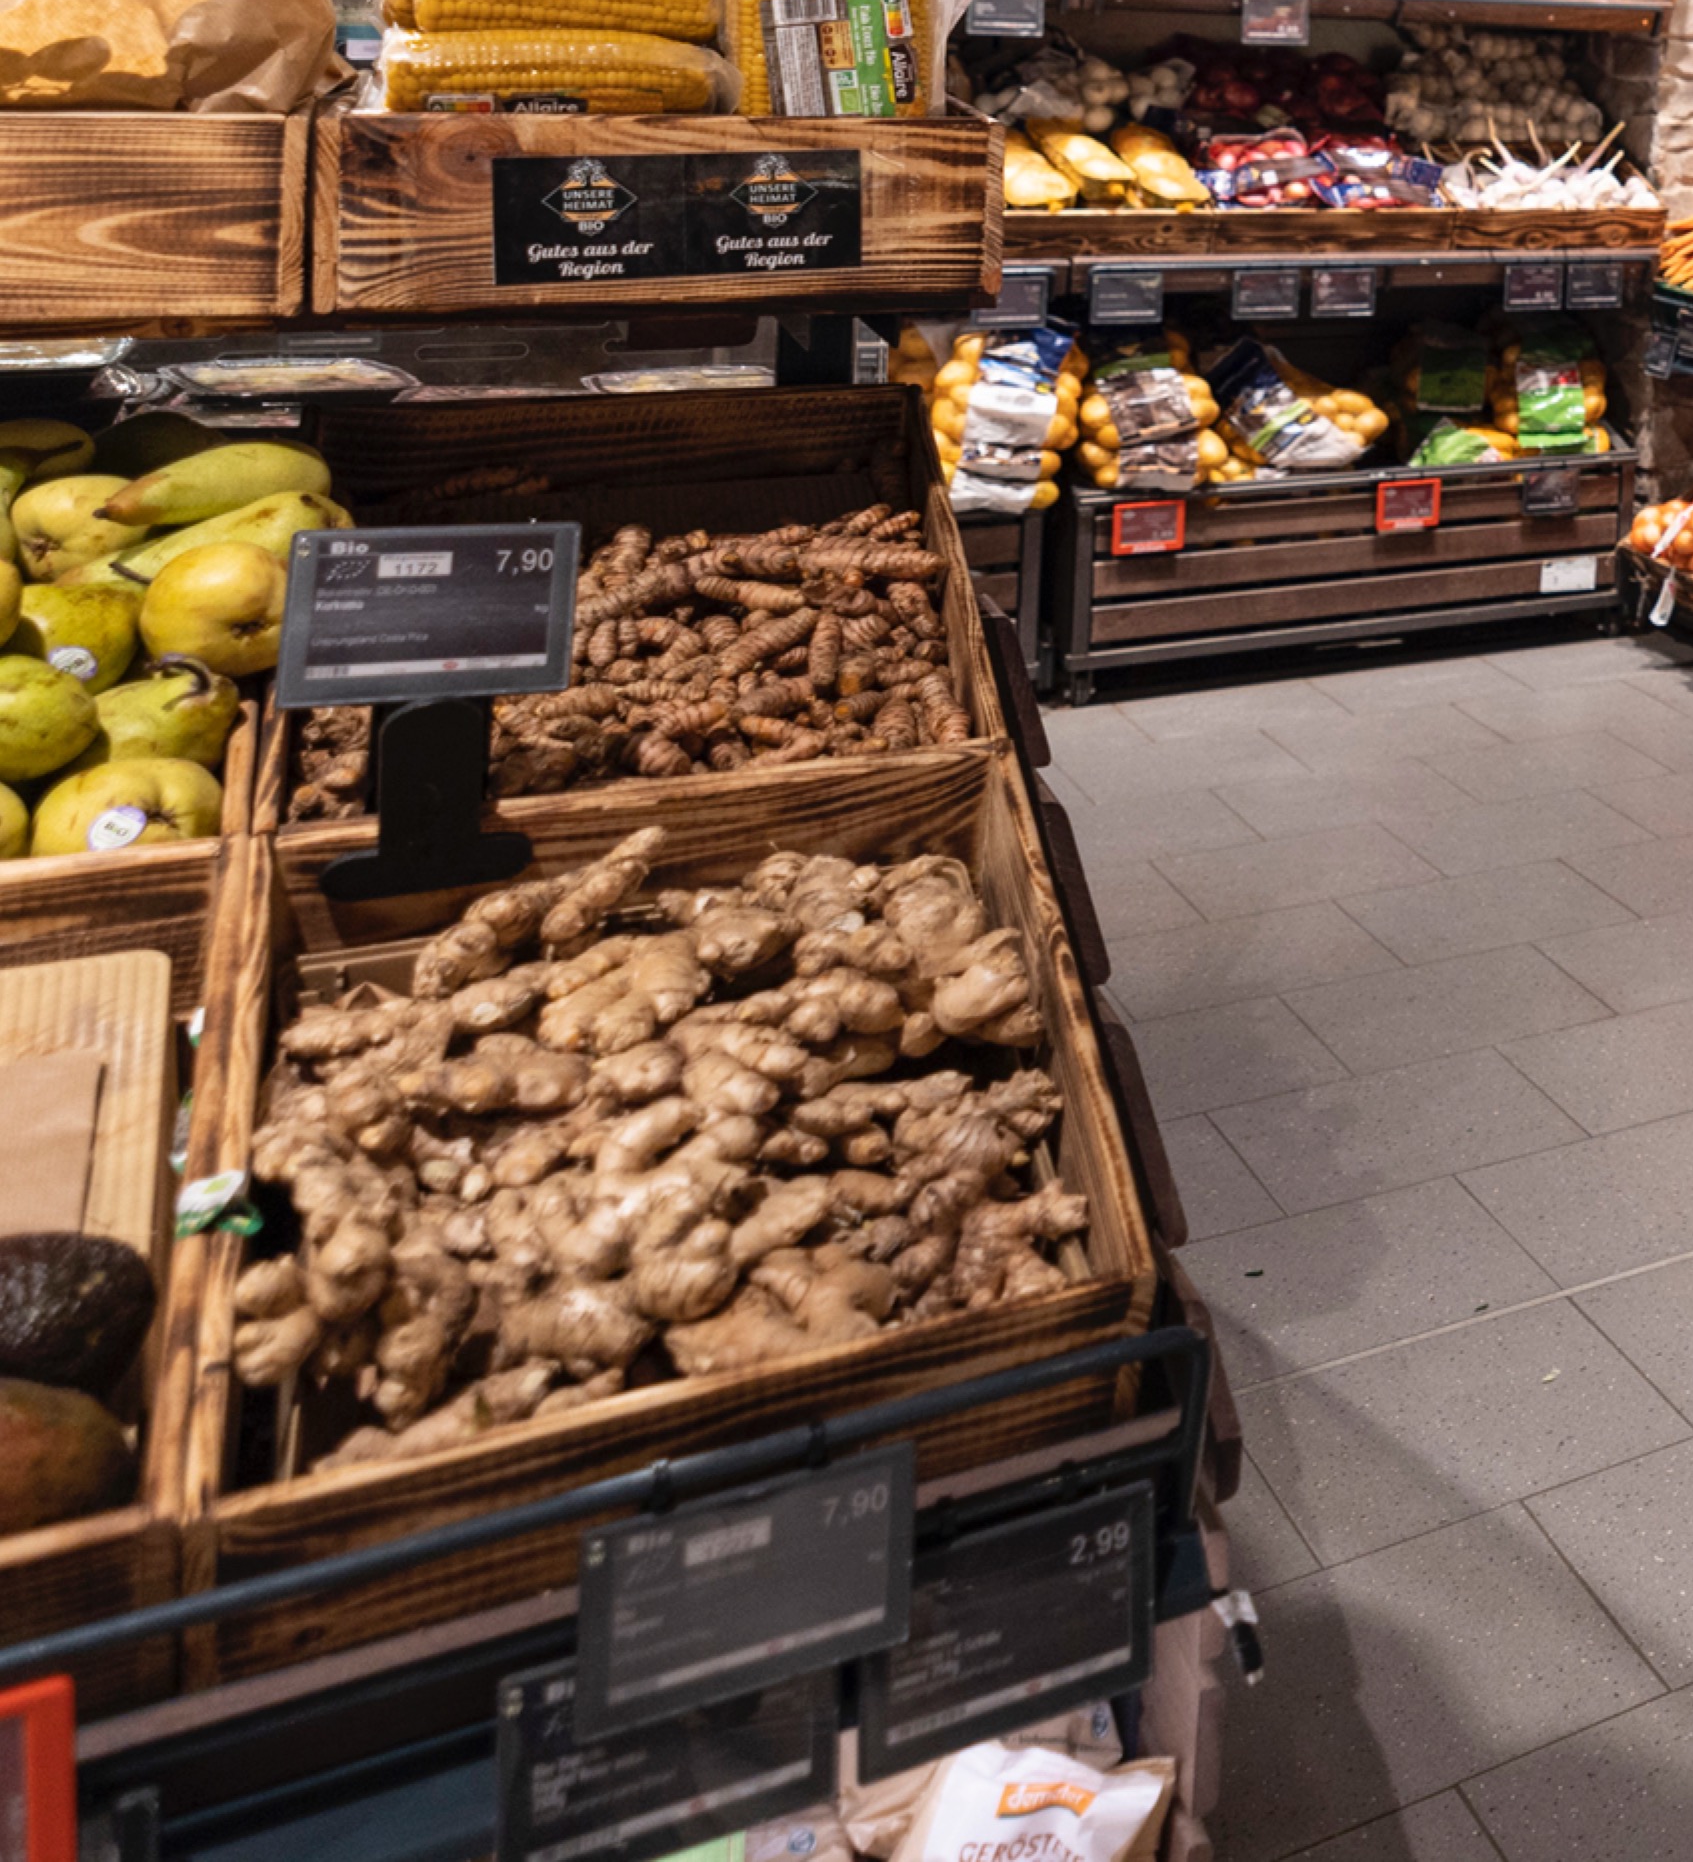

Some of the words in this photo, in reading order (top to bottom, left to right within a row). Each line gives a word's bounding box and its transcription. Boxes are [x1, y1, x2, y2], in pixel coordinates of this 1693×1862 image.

[890, 51, 909, 99] Allaire
[514, 100, 580, 114] Allaire
[562, 189, 615, 200] UNSERE
[748, 183, 796, 195] UNSERE
[563, 199, 615, 211] HEIMAT
[749, 193, 796, 204] HEIMAT
[578, 220, 605, 232] BIO
[762, 213, 787, 225] BIO
[715, 235, 764, 253] Gutes
[767, 235, 799, 248] aus
[803, 232, 833, 247] der
[528, 242, 580, 264] Gutes
[583, 243, 618, 257] aus
[621, 240, 654, 256] der
[744, 250, 805, 270] Region
[558, 259, 625, 280] Region
[329, 541, 370, 556] Bio
[496, 547, 553, 576] 7,90
[820, 1483, 889, 1529] 7,90
[1068, 1521, 1131, 1565] 2,99
